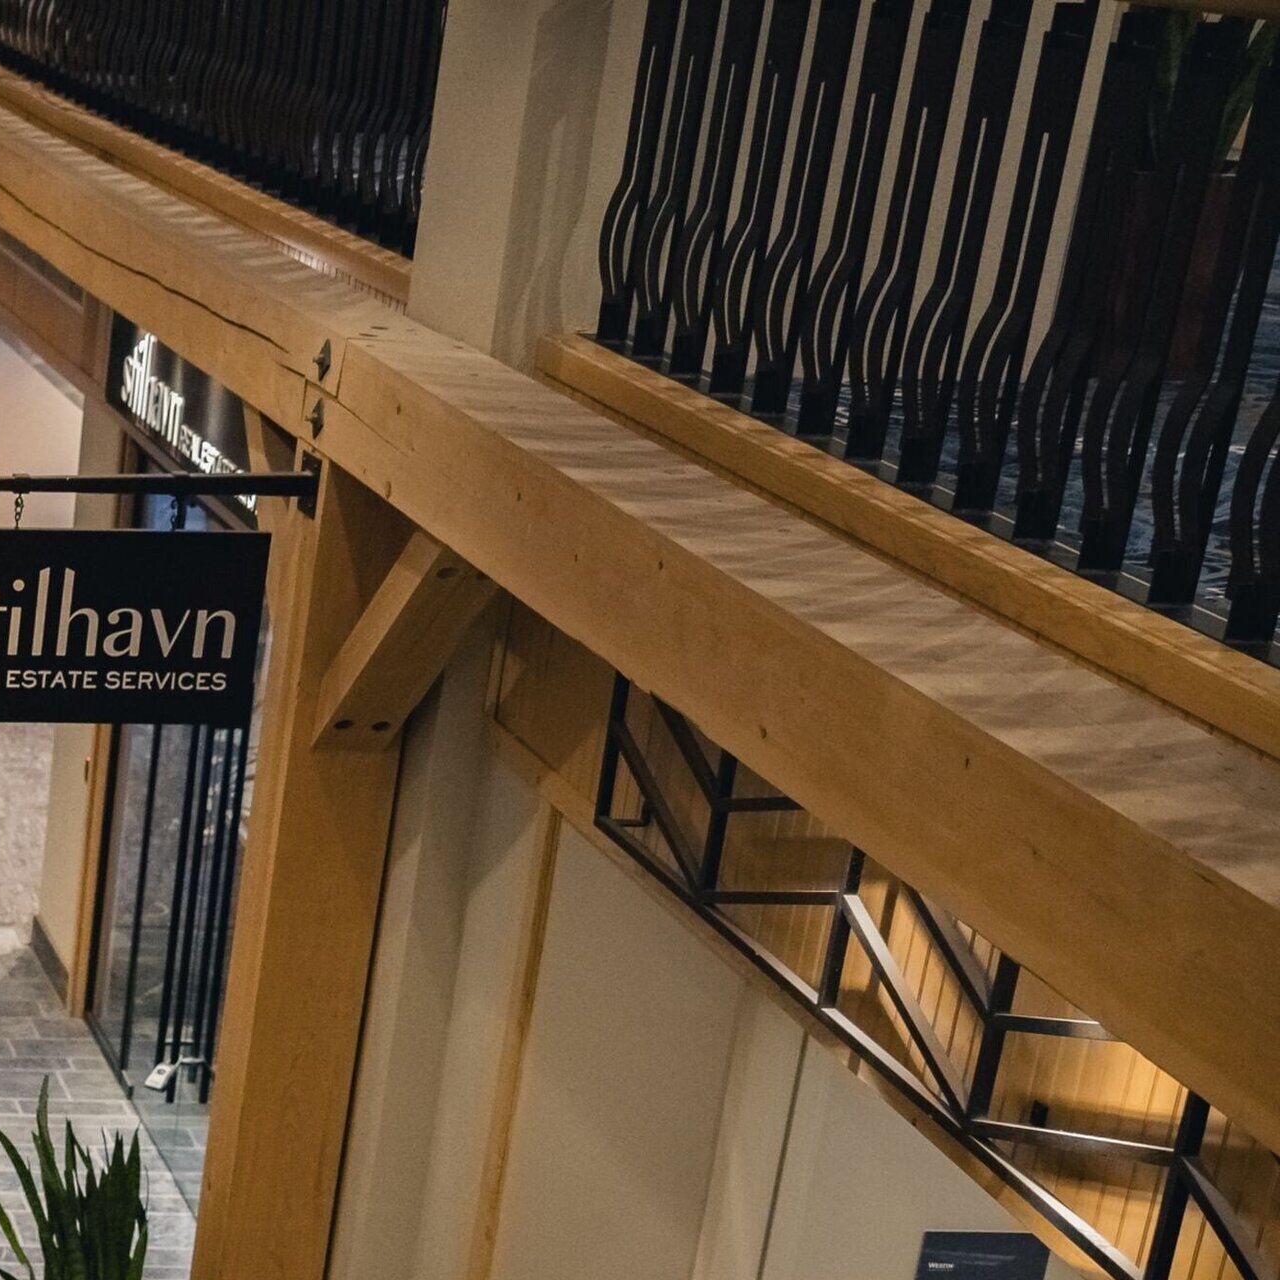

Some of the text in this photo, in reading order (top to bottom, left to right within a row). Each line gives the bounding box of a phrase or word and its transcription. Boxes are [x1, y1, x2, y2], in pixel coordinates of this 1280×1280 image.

[121, 332, 185, 447] stilhavn
[6, 670, 98, 689] ESTATE
[104, 671, 227, 691] SERVICES
